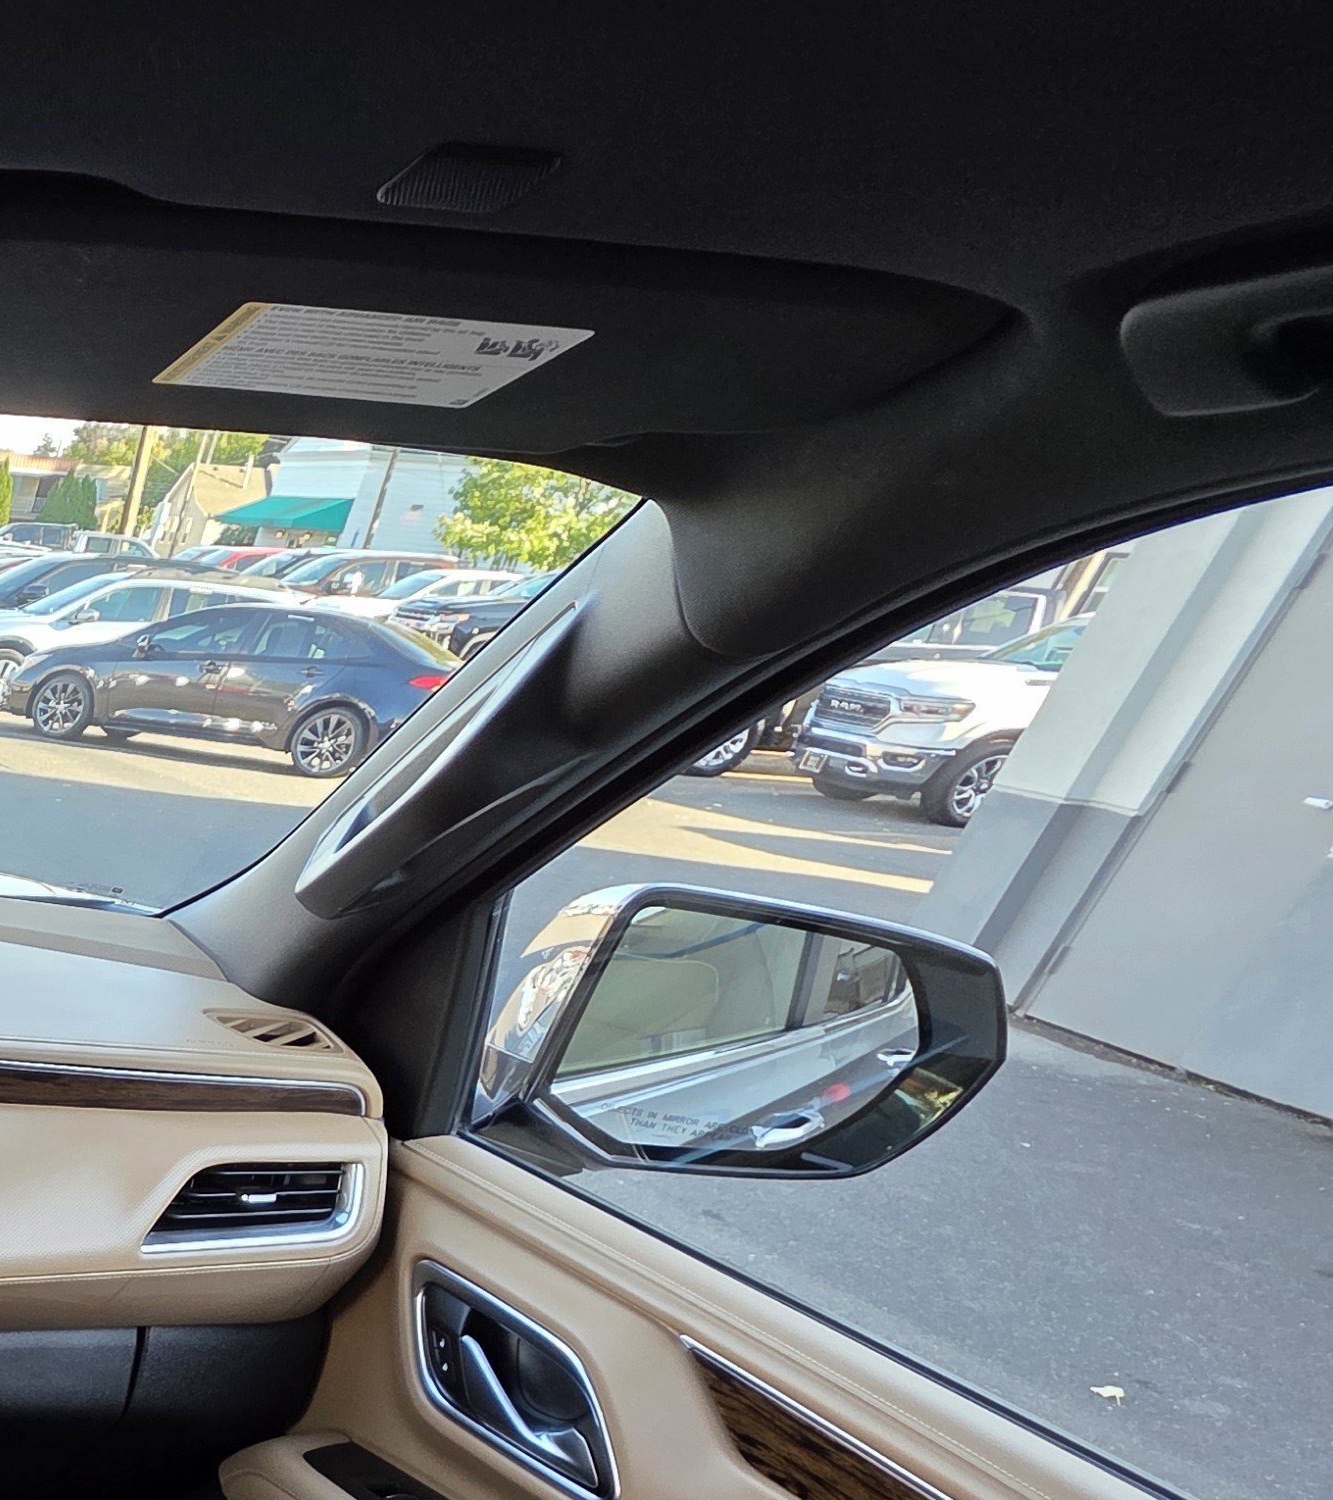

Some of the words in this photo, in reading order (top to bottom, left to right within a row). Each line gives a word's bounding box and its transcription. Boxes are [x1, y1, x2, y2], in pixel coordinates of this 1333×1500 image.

[830, 699, 861, 711] RAM
[630, 1117, 658, 1130] THAN
[661, 1123, 687, 1135] THEY
[647, 1110, 658, 1120] IN
[662, 1113, 701, 1127] MIRROR
